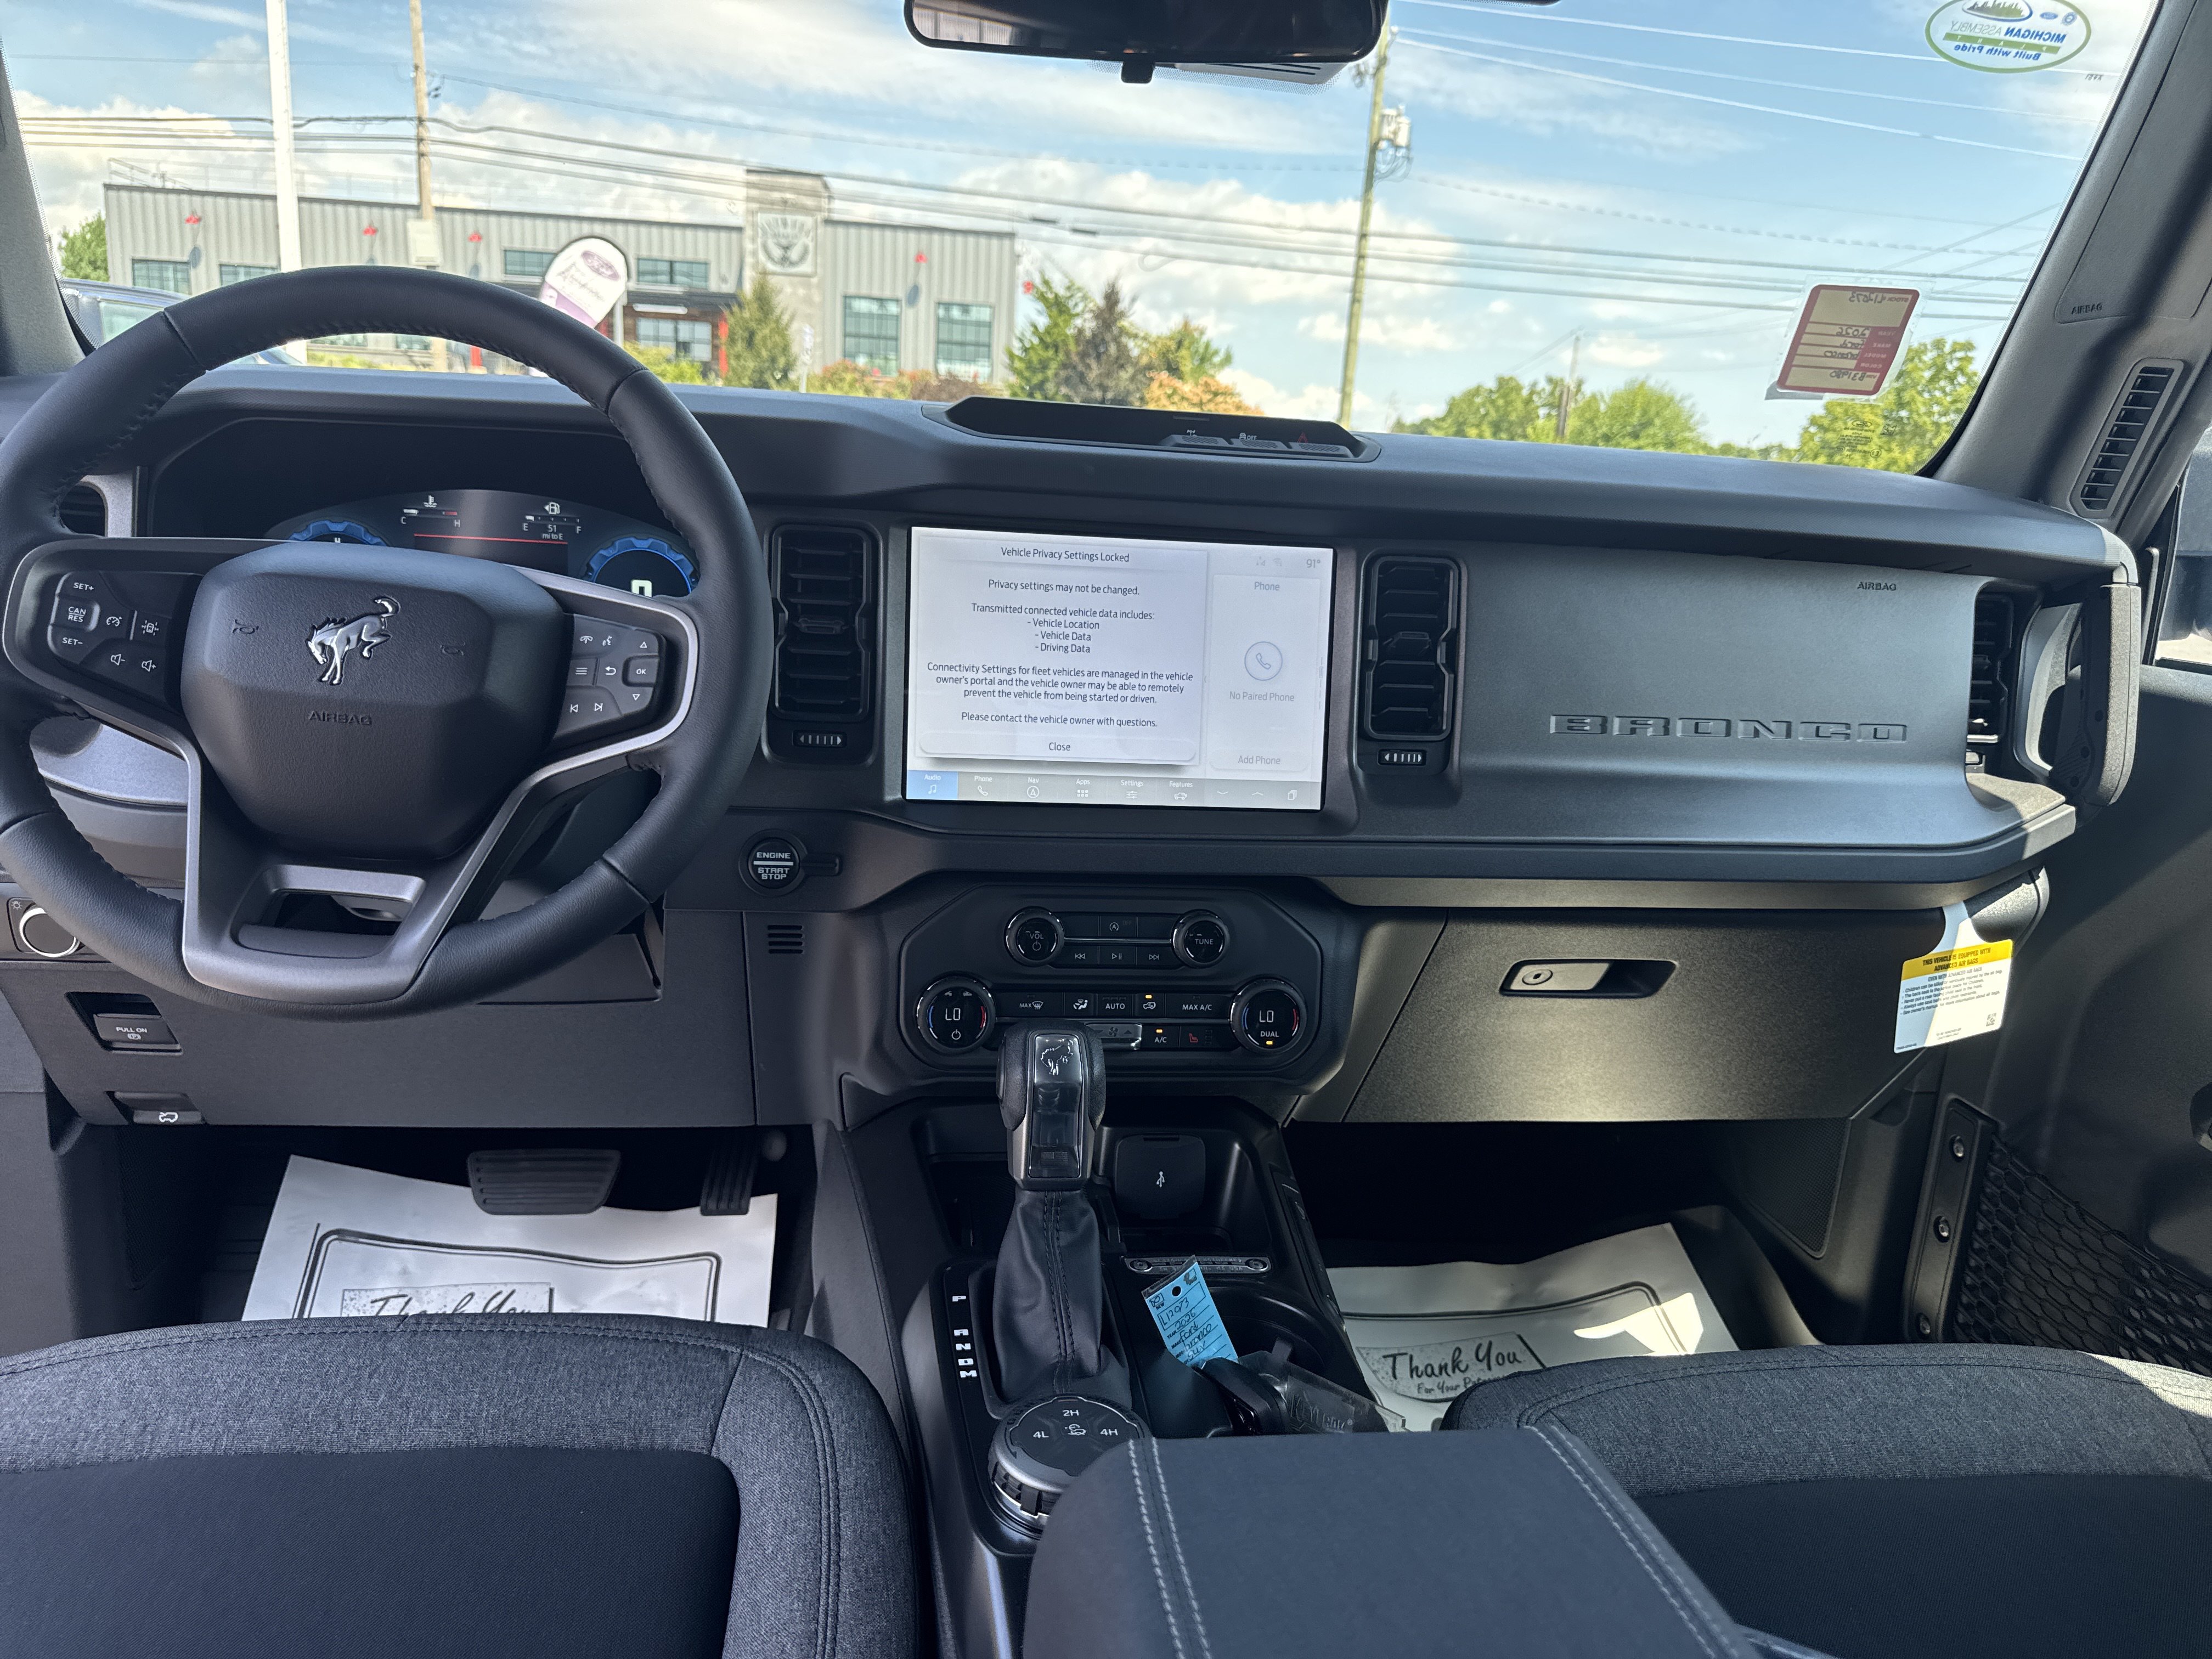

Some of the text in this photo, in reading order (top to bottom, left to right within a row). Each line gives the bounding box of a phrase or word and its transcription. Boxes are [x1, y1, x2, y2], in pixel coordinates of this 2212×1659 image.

[2072, 302, 2103, 315] AIRBAG
[399, 516, 407, 524] C
[454, 519, 461, 528] H
[522, 523, 528, 531] E
[548, 524, 557, 533] 51
[576, 526, 582, 534] F
[1001, 546, 1130, 562] Vehicle Privacy Settings Locked
[73, 582, 94, 591] SET+
[989, 579, 1140, 596] Privacy settings may not be changed.
[1254, 582, 1280, 591] Phone
[1857, 580, 1897, 591] AIRBAG
[68, 606, 87, 616] CAN
[971, 603, 1155, 620] Transmitted connected vehicle data includes:
[68, 614, 83, 623] RES
[1032, 618, 1099, 630] Vehicle Location
[1040, 631, 1091, 641] Vehicle Data
[1040, 642, 1091, 654] Driving Data
[927, 662, 980, 674] Connectivity
[981, 664, 1017, 675] Settings
[1018, 666, 1030, 675] for
[1031, 666, 1051, 675] fleet
[1052, 667, 1085, 677] vehicles
[1101, 670, 1139, 680] managed
[1141, 670, 1148, 679] in
[1150, 671, 1164, 680] the
[1165, 672, 1193, 681] vehicle
[936, 675, 969, 684] owner's
[970, 677, 995, 686] portal
[997, 677, 1013, 686] and
[1015, 678, 1029, 686] the
[1030, 678, 1059, 688] vehicle
[1087, 682, 1105, 691] may
[1107, 681, 1117, 690] be
[1118, 681, 1136, 691] able
[1138, 682, 1147, 691] to
[1148, 684, 1184, 693] remotely
[963, 689, 996, 698] prevent
[997, 689, 1012, 698] the
[1013, 690, 1042, 699] vehicle
[1043, 690, 1063, 700] from
[1065, 691, 1087, 702] being
[1088, 693, 1118, 702] started
[1130, 695, 1157, 703] driven.
[1229, 691, 1295, 702] No Paired Phone
[308, 710, 373, 726] AIRBAG
[961, 712, 989, 721] Please
[991, 714, 1023, 722] contact
[1024, 714, 1038, 723] the
[1039, 714, 1068, 724] vehicle
[1096, 716, 1115, 726] with
[1116, 718, 1158, 727] questions.
[1549, 713, 1907, 743] BRONCO
[1049, 742, 1071, 751] Close
[1238, 755, 1280, 765] Add Phone
[1075, 778, 1091, 787] Apps
[1120, 779, 1144, 788] Settings
[1933, 955, 1952, 963] VEHICLE
[1957, 950, 1978, 959] EQUIPPED
[1933, 962, 1957, 972] ADVANCED
[1199, 1003, 1212, 1012] A/C
[945, 1007, 961, 1020] LO
[1259, 1009, 1274, 1023] LO
[1155, 1301, 1165, 1310] NEW
[1166, 1307, 1196, 1340] YEAR 2026
[1171, 1321, 1198, 1350] MAKE Ford
[1187, 1341, 1206, 1359] SUV
[1383, 1340, 1522, 1380] Thank You
[960, 1370, 978, 1378] M
[1417, 1382, 1435, 1393] For
[1437, 1380, 1460, 1393] Your
